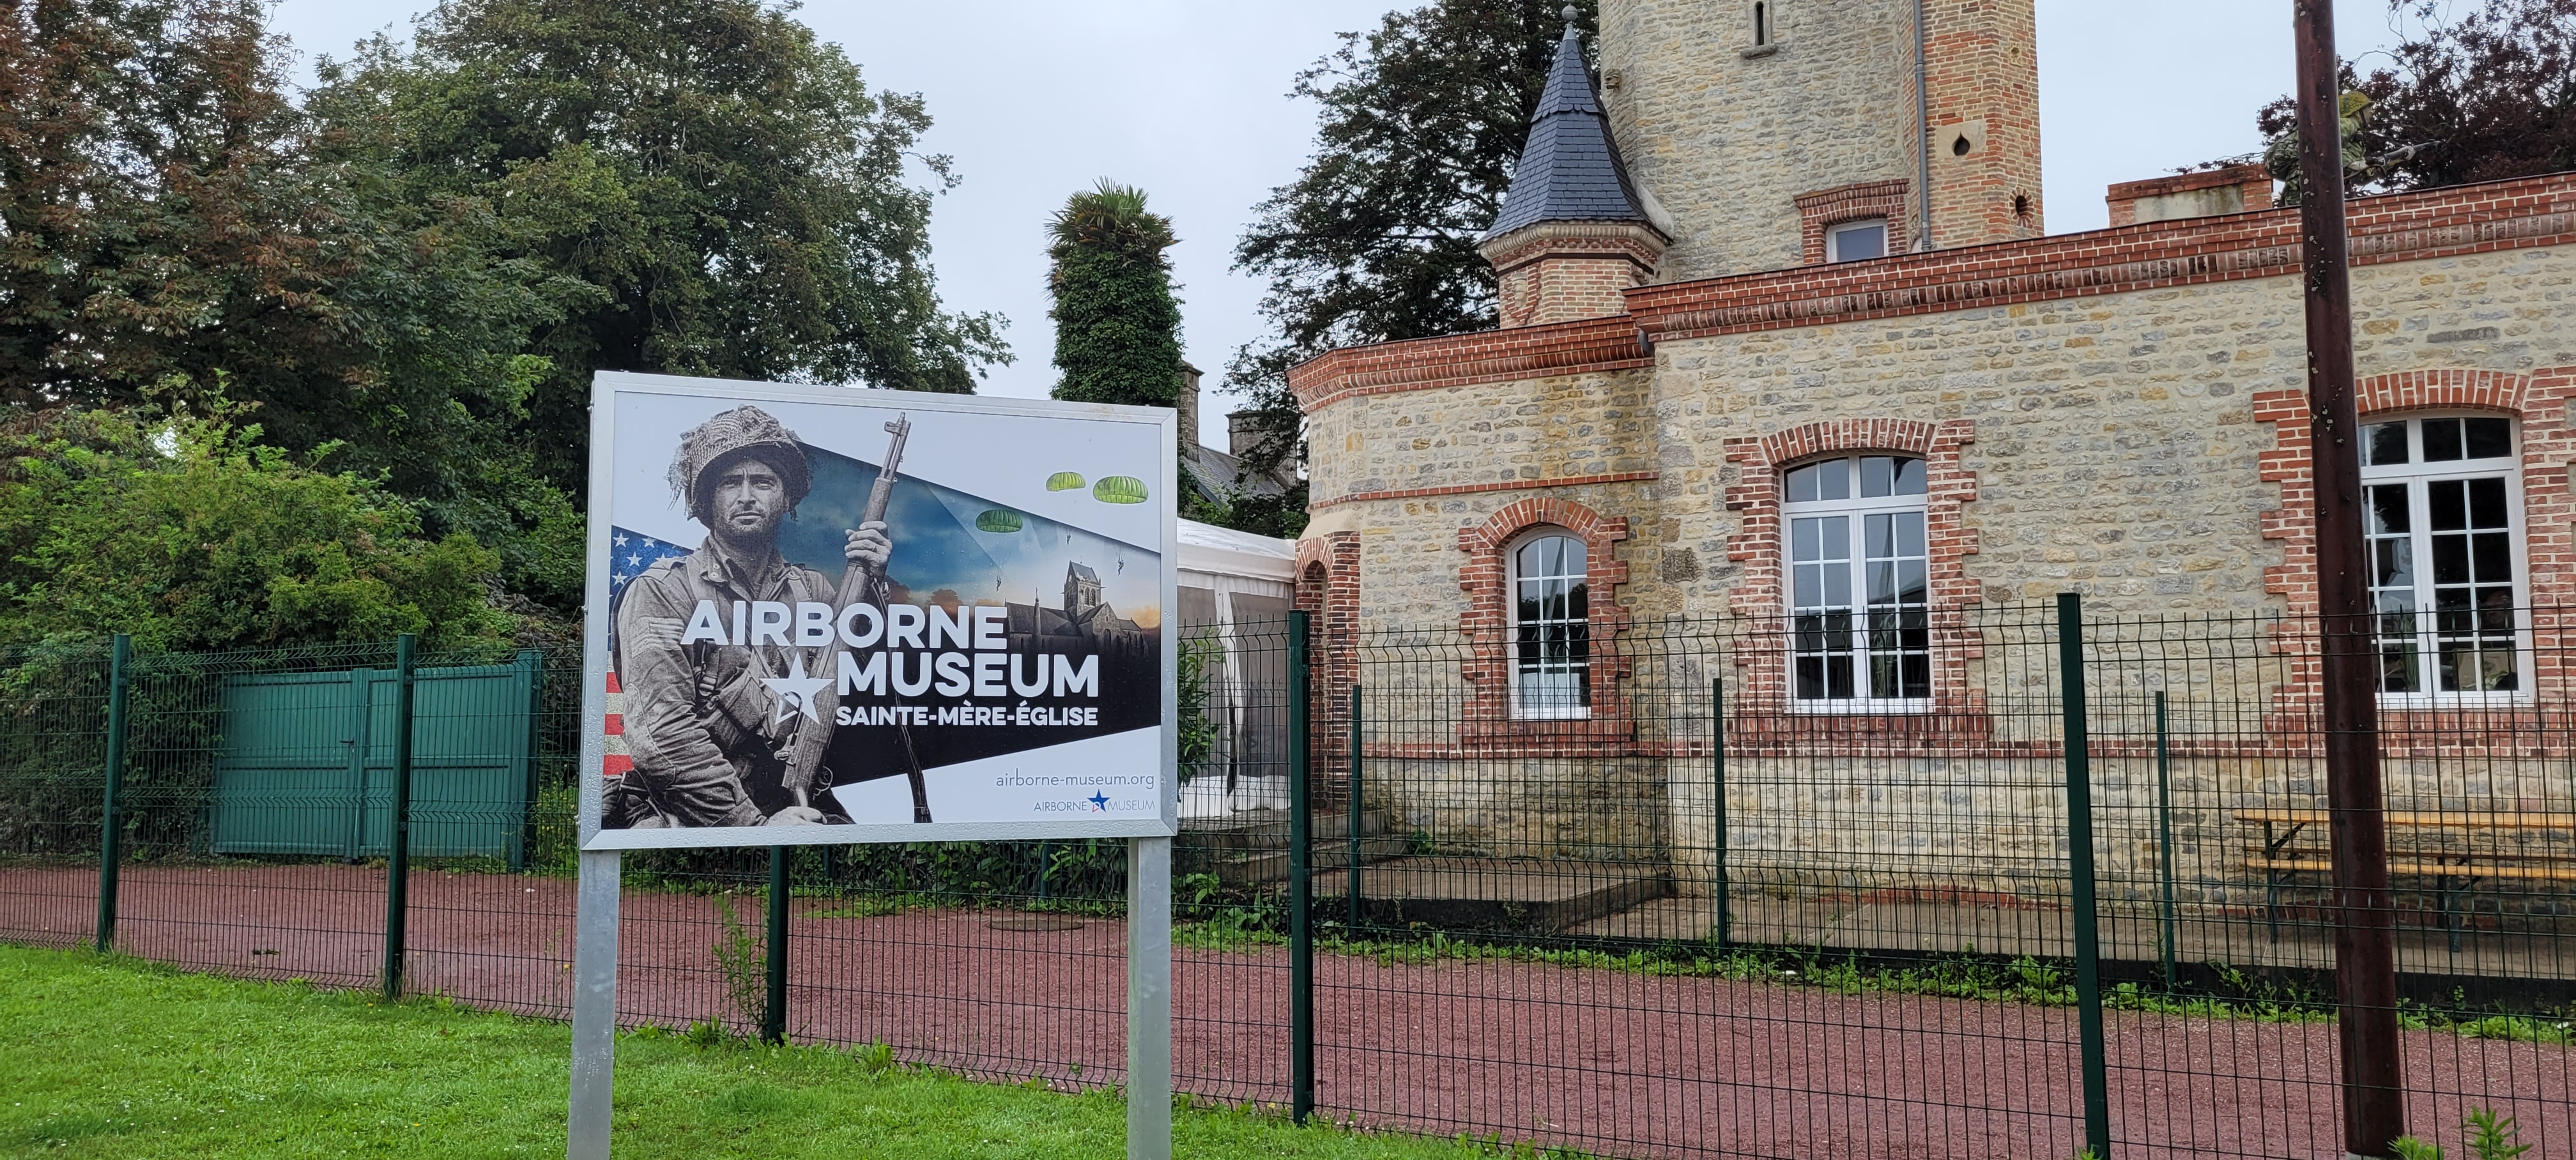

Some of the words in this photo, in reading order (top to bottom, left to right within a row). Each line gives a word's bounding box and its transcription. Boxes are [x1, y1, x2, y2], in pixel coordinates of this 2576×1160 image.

[680, 600, 1008, 650] AIRBORNE
[837, 652, 1099, 698] MUSEUM
[836, 699, 1098, 726] SAINTE-MÈRE-ÉGLISE
[996, 768, 1154, 790] airborne-museum.org
[1033, 802, 1087, 812] AIRBORNE
[1107, 800, 1156, 811] MUSEUM
